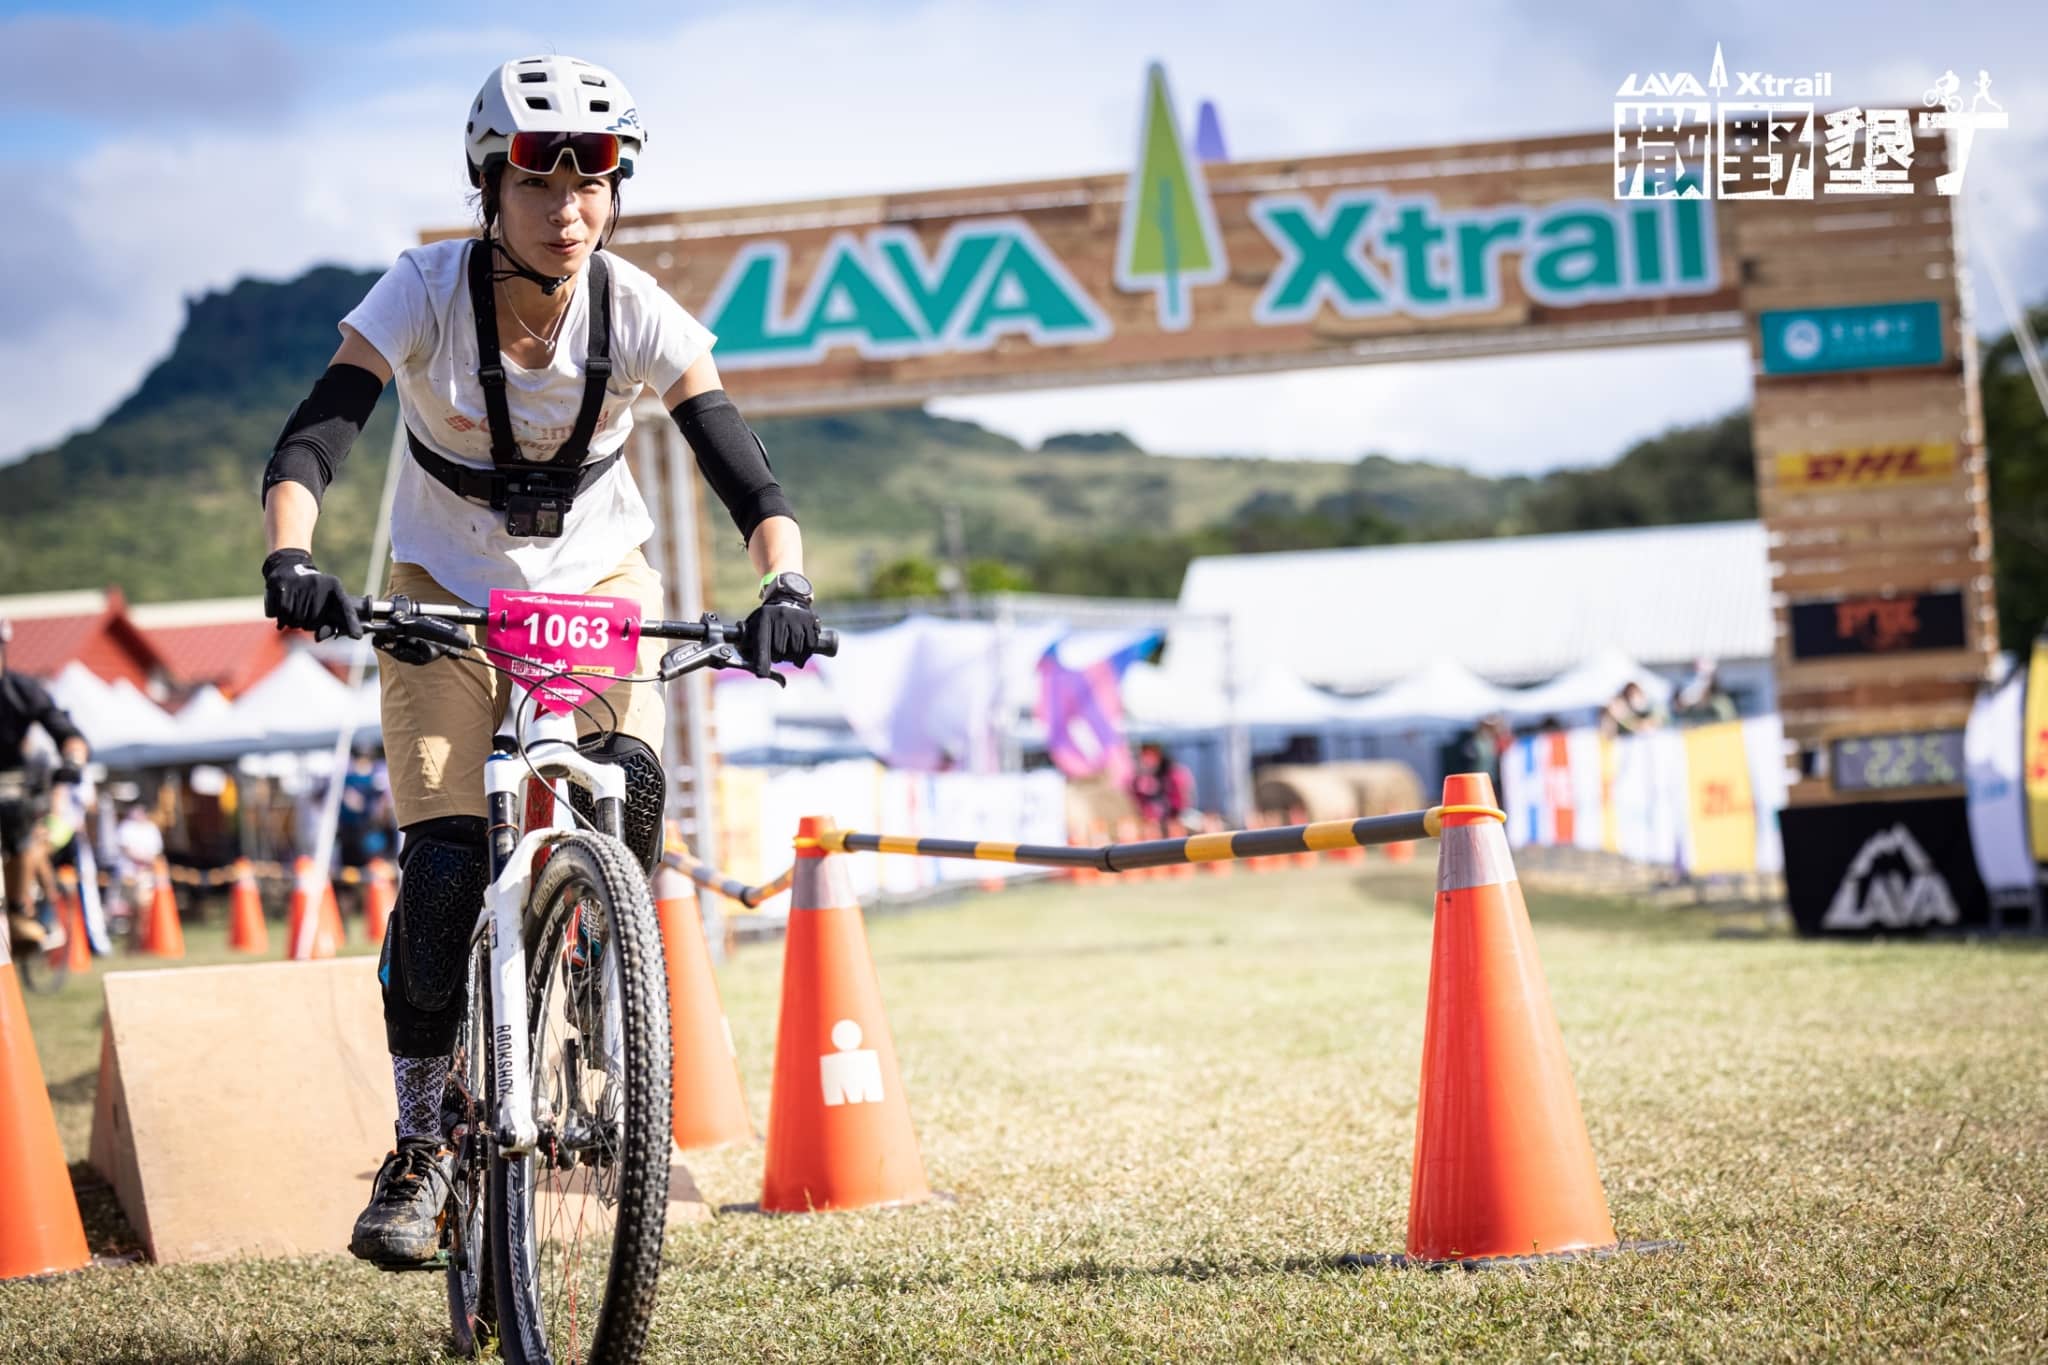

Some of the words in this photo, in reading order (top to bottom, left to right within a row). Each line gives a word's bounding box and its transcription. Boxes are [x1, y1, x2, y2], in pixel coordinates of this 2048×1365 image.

[708, 230, 1095, 356] LAVA
[1263, 176, 1708, 315] Xtrail
[1805, 449, 1924, 486] DHL
[524, 613, 609, 650] 1063
[1821, 870, 1962, 930] LAVA
